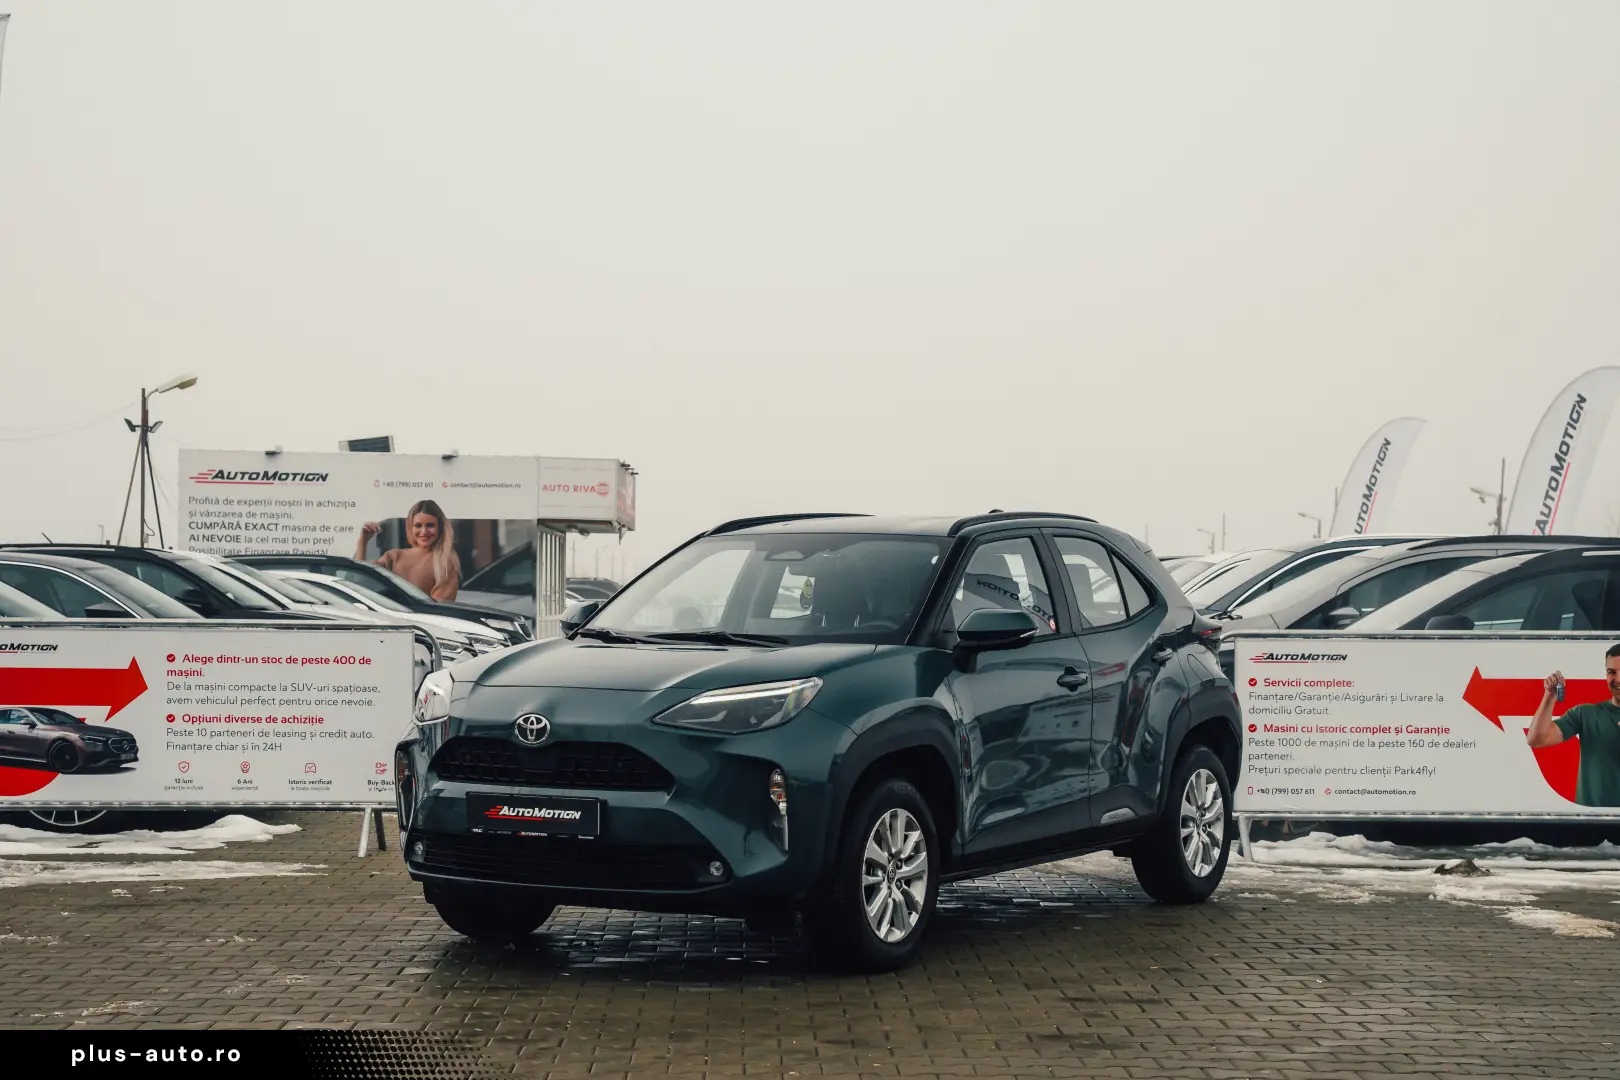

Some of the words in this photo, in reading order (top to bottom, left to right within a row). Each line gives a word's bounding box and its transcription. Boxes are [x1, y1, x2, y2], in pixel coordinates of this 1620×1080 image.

[542, 484, 570, 492] AUTO
[574, 485, 598, 494] RIVA
[1354, 437, 1392, 535] UTOMOTION
[189, 496, 220, 505] Profită
[237, 499, 272, 507] experții
[275, 500, 302, 508] noștri
[305, 499, 313, 507] în
[316, 500, 356, 509] achiziția
[188, 510, 196, 521] și
[199, 510, 243, 520] vânzarea
[259, 512, 294, 522] mașini.
[189, 521, 242, 530] CUMPĂRĂ
[245, 523, 279, 531] EXACT
[282, 525, 316, 533] mașina
[319, 524, 331, 532] de
[189, 534, 199, 542] AI
[202, 534, 241, 543] NEVOIE
[292, 536, 310, 544] bun
[0, 642, 59, 651] OMOTION
[183, 654, 213, 665] Alege
[217, 655, 258, 663] dintr-un
[286, 656, 298, 664] de
[302, 657, 330, 666] peste
[333, 656, 356, 664] 400
[359, 656, 371, 665] de
[167, 668, 204, 678] mașini.
[167, 682, 181, 690] De
[184, 682, 191, 690] la
[195, 683, 225, 693] mașini
[229, 684, 276, 693] compacte
[280, 683, 287, 691] la
[291, 683, 329, 692] SUV-uri
[1264, 678, 1301, 687] Servicii
[1304, 679, 1354, 689] complete:
[195, 696, 237, 704] vehiculul
[241, 696, 276, 707] perfect
[279, 698, 311, 707] pentru
[314, 697, 338, 706] orice
[341, 698, 375, 706] nevoie.
[1391, 693, 1398, 704] și
[1401, 693, 1433, 702] Livrare
[1436, 694, 1443, 702] la
[1249, 705, 1291, 714] domiciliu
[1295, 706, 1331, 714] Gratuit.
[182, 714, 221, 724] Opțiuni
[224, 715, 262, 723] diverse
[265, 715, 278, 723] de
[281, 715, 324, 726] achiziție
[167, 728, 193, 736] Peste
[197, 728, 207, 736] 10
[210, 729, 254, 738] parteneri
[258, 729, 270, 737] de
[273, 729, 306, 740] leasing
[310, 730, 316, 740] și
[319, 729, 347, 738] credit
[1264, 724, 1298, 732] Masini
[1316, 725, 1347, 733] Istoric
[1350, 725, 1391, 735] complet
[1395, 725, 1403, 736] și
[1406, 725, 1450, 736] Garanție
[167, 742, 212, 753] Finanțare
[215, 742, 239, 750] chiar
[242, 743, 248, 753] și
[251, 743, 259, 751] în
[263, 743, 281, 751] 24H
[1249, 738, 1275, 746] Peste
[1278, 738, 1301, 746] 1000
[1304, 737, 1316, 747] de
[1320, 739, 1349, 748] mașini
[1353, 739, 1364, 747] de
[1368, 739, 1375, 747] la
[1379, 740, 1405, 749] peste
[1409, 739, 1424, 747] 160
[1428, 739, 1440, 748] de
[1443, 739, 1475, 748] dealeri
[1249, 753, 1294, 762] parteneri.
[1249, 765, 1280, 776] Prețuri
[1284, 766, 1322, 775] speciale
[1325, 767, 1357, 776] pentru
[1360, 766, 1391, 777] clienții
[1395, 766, 1435, 777] Park4fly!
